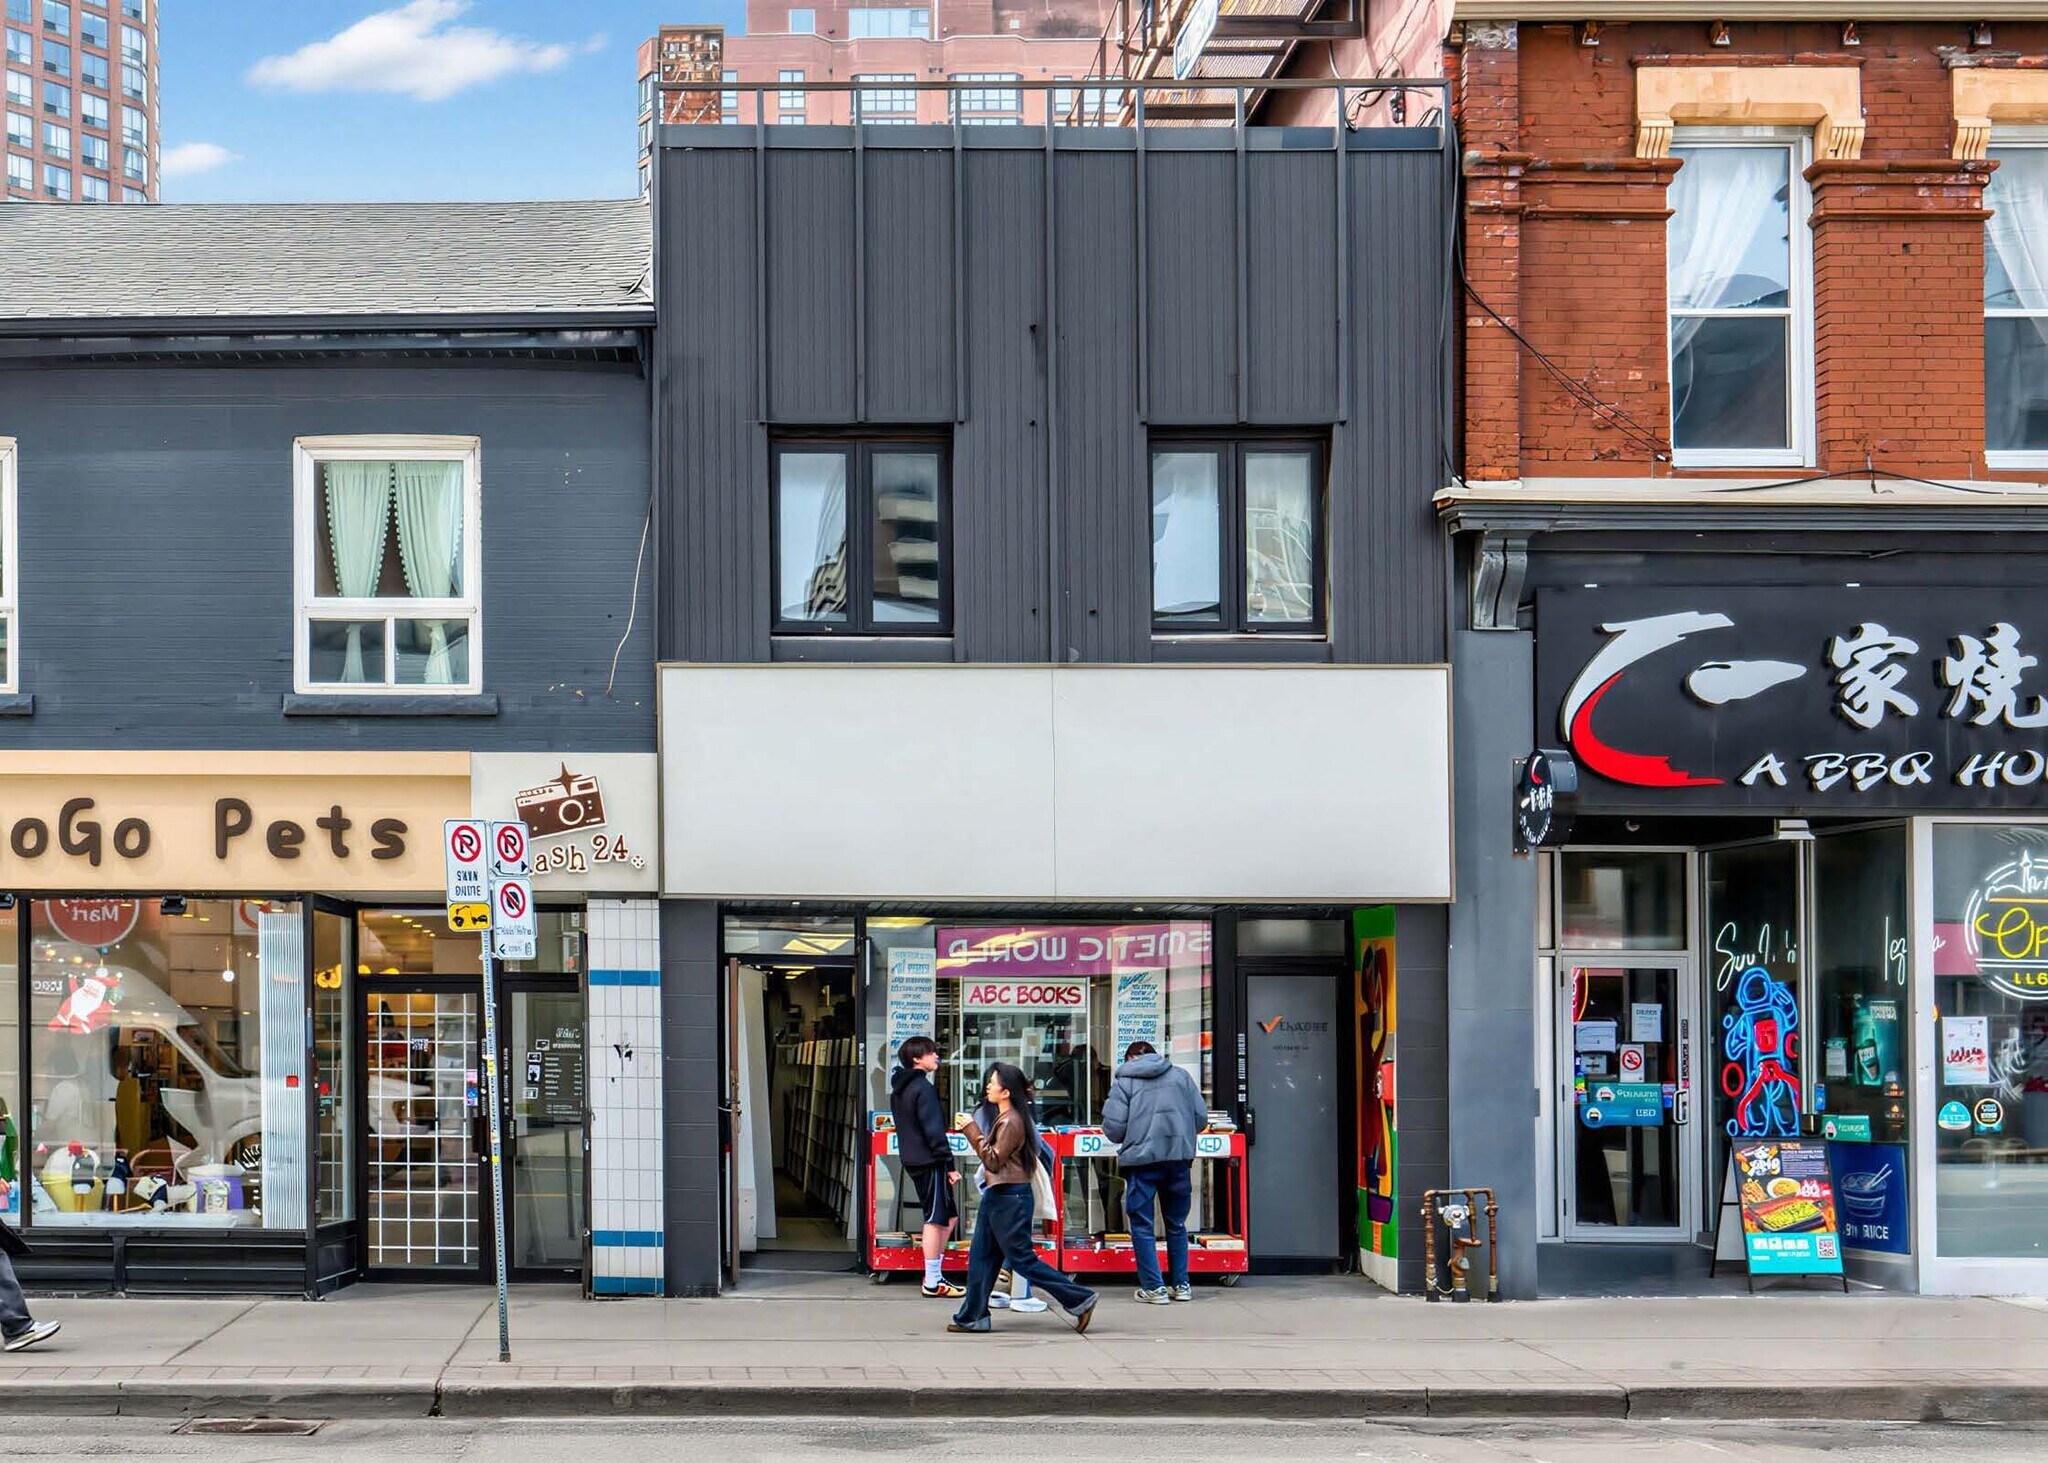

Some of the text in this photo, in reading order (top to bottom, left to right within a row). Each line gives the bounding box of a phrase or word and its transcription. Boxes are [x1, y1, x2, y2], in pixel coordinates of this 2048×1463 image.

[1738, 750, 2048, 792] A BBQ HO
[215, 797, 408, 860] Pets
[969, 984, 1082, 1005] ABC BOOKS
